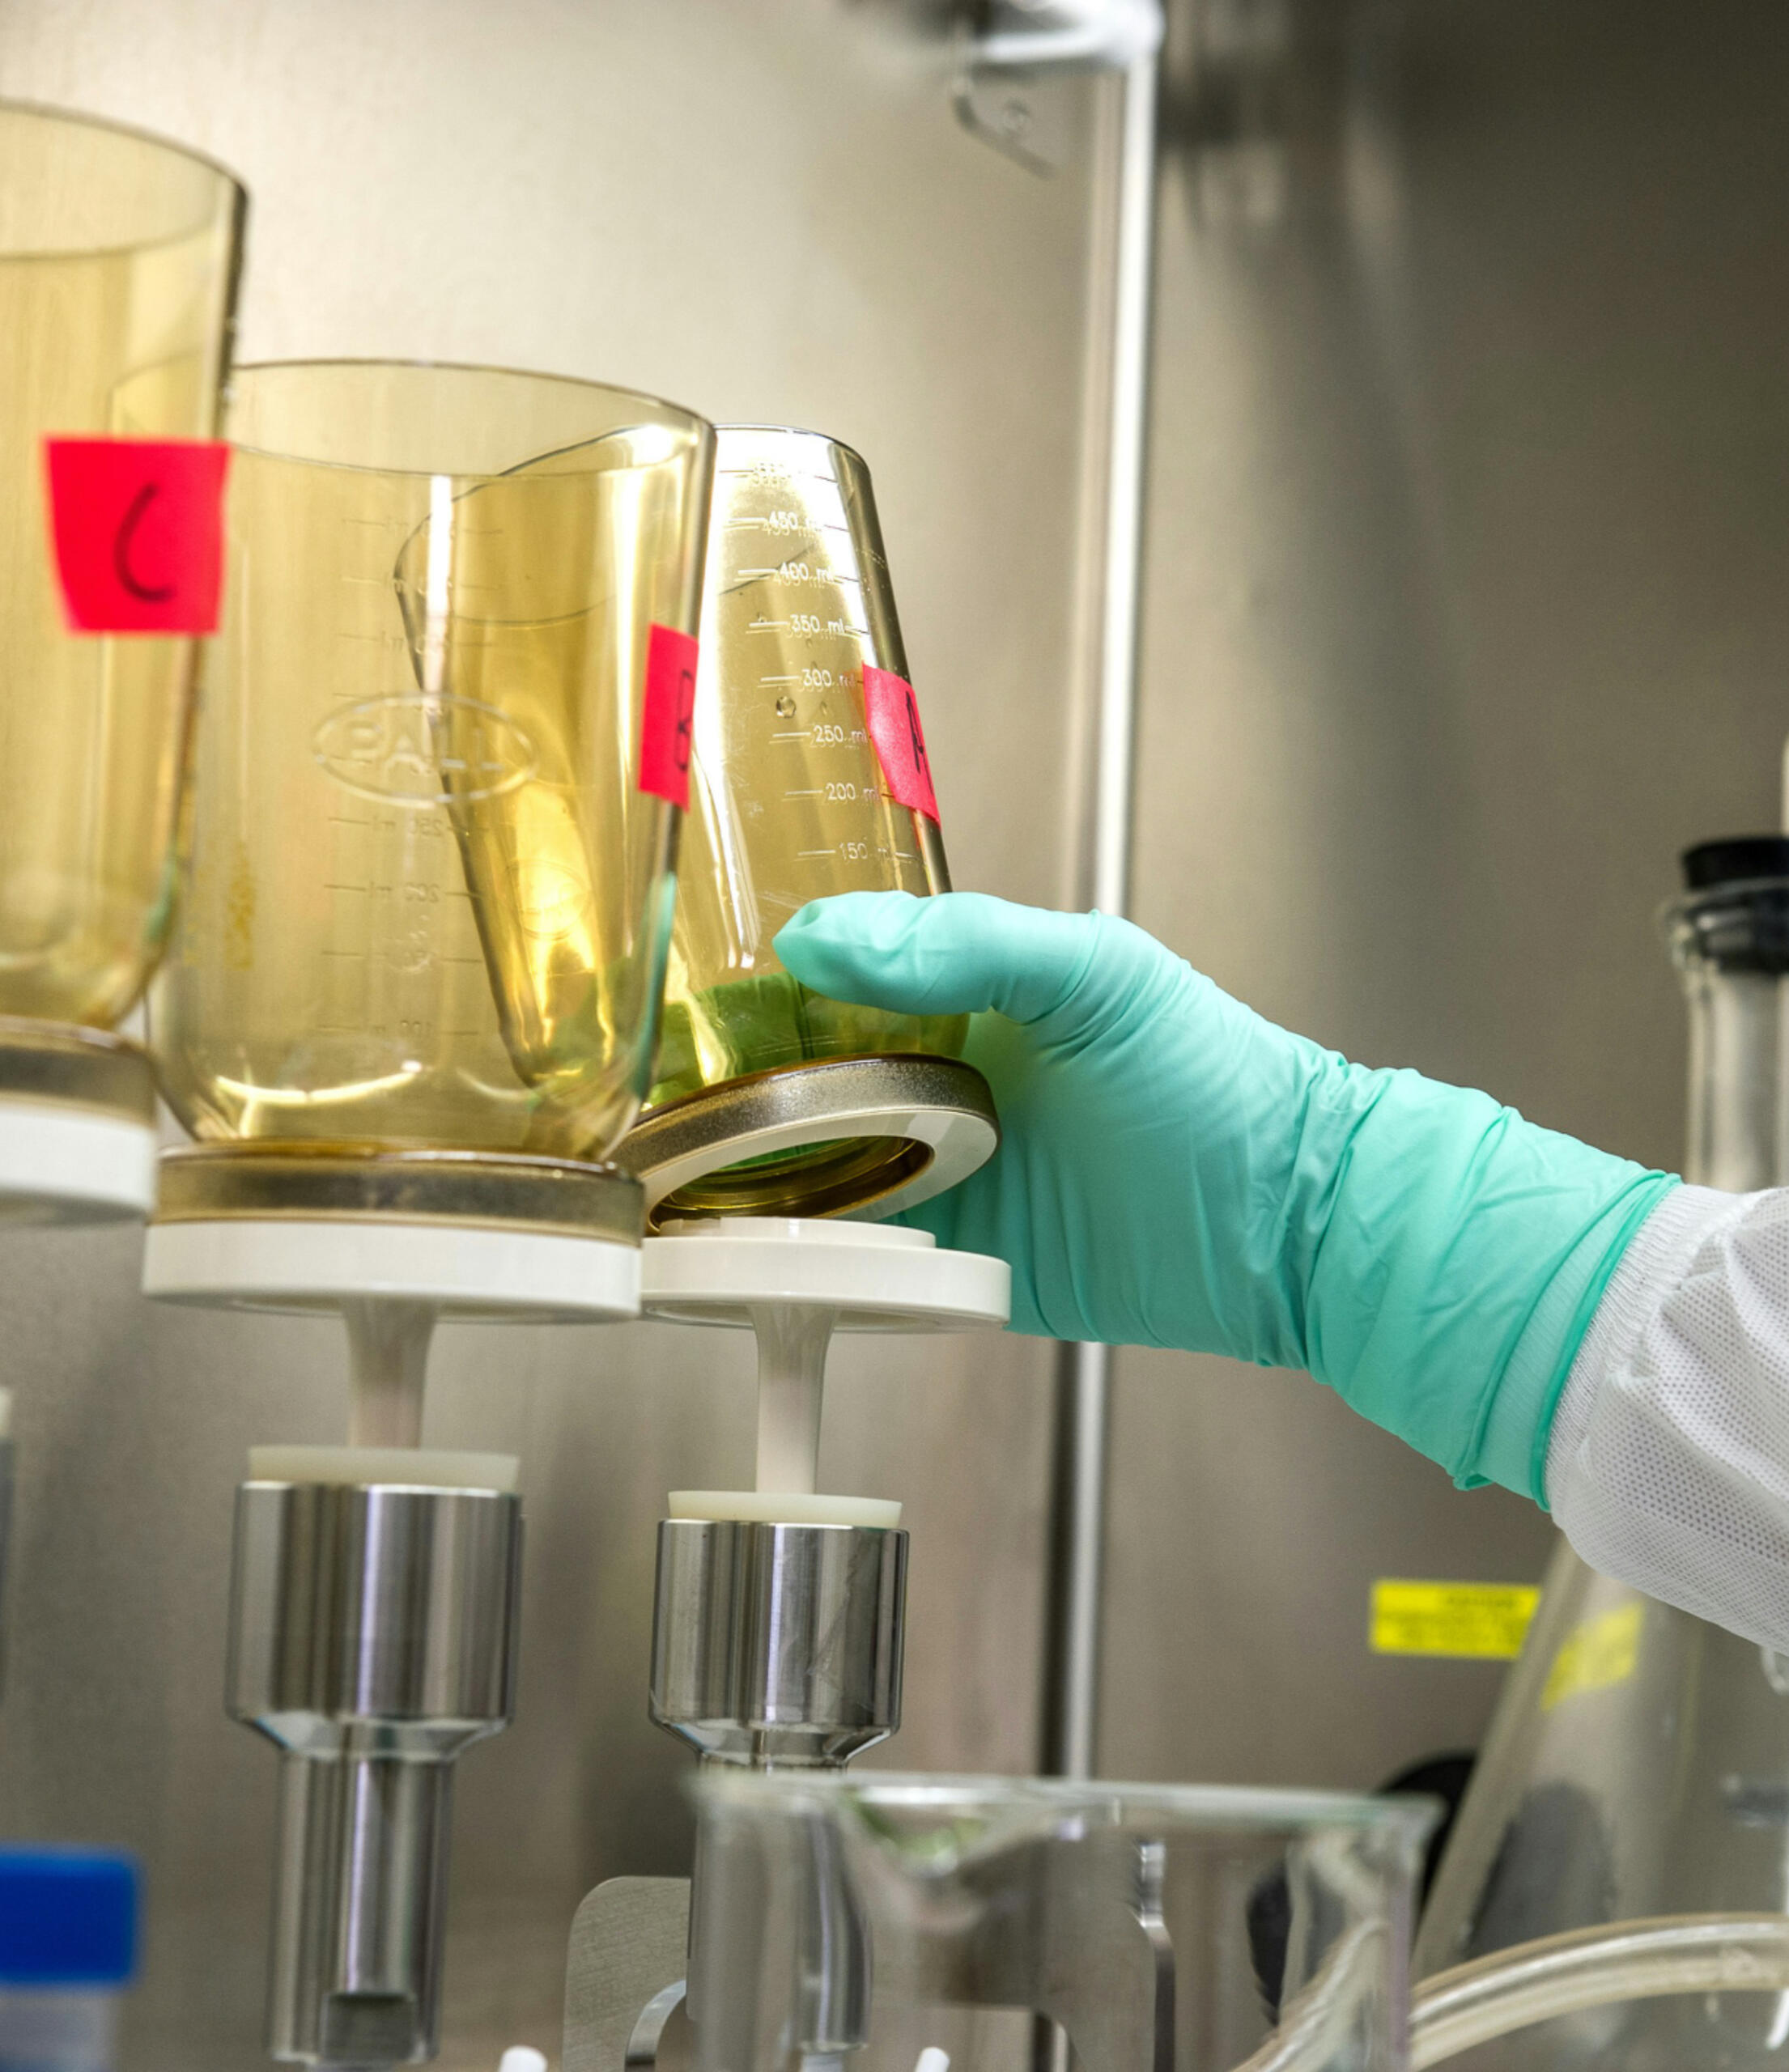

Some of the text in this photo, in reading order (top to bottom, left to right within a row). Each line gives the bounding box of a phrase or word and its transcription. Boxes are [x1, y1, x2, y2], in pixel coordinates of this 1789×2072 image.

[769, 511, 798, 531] 450
[113, 482, 174, 603] C
[780, 563, 810, 581] 400
[790, 614, 845, 634] 350 ml
[801, 669, 833, 687] 300
[813, 725, 869, 744] 250 ml
[905, 690, 935, 795] A
[825, 783, 856, 800] 200
[839, 843, 869, 860] 150
